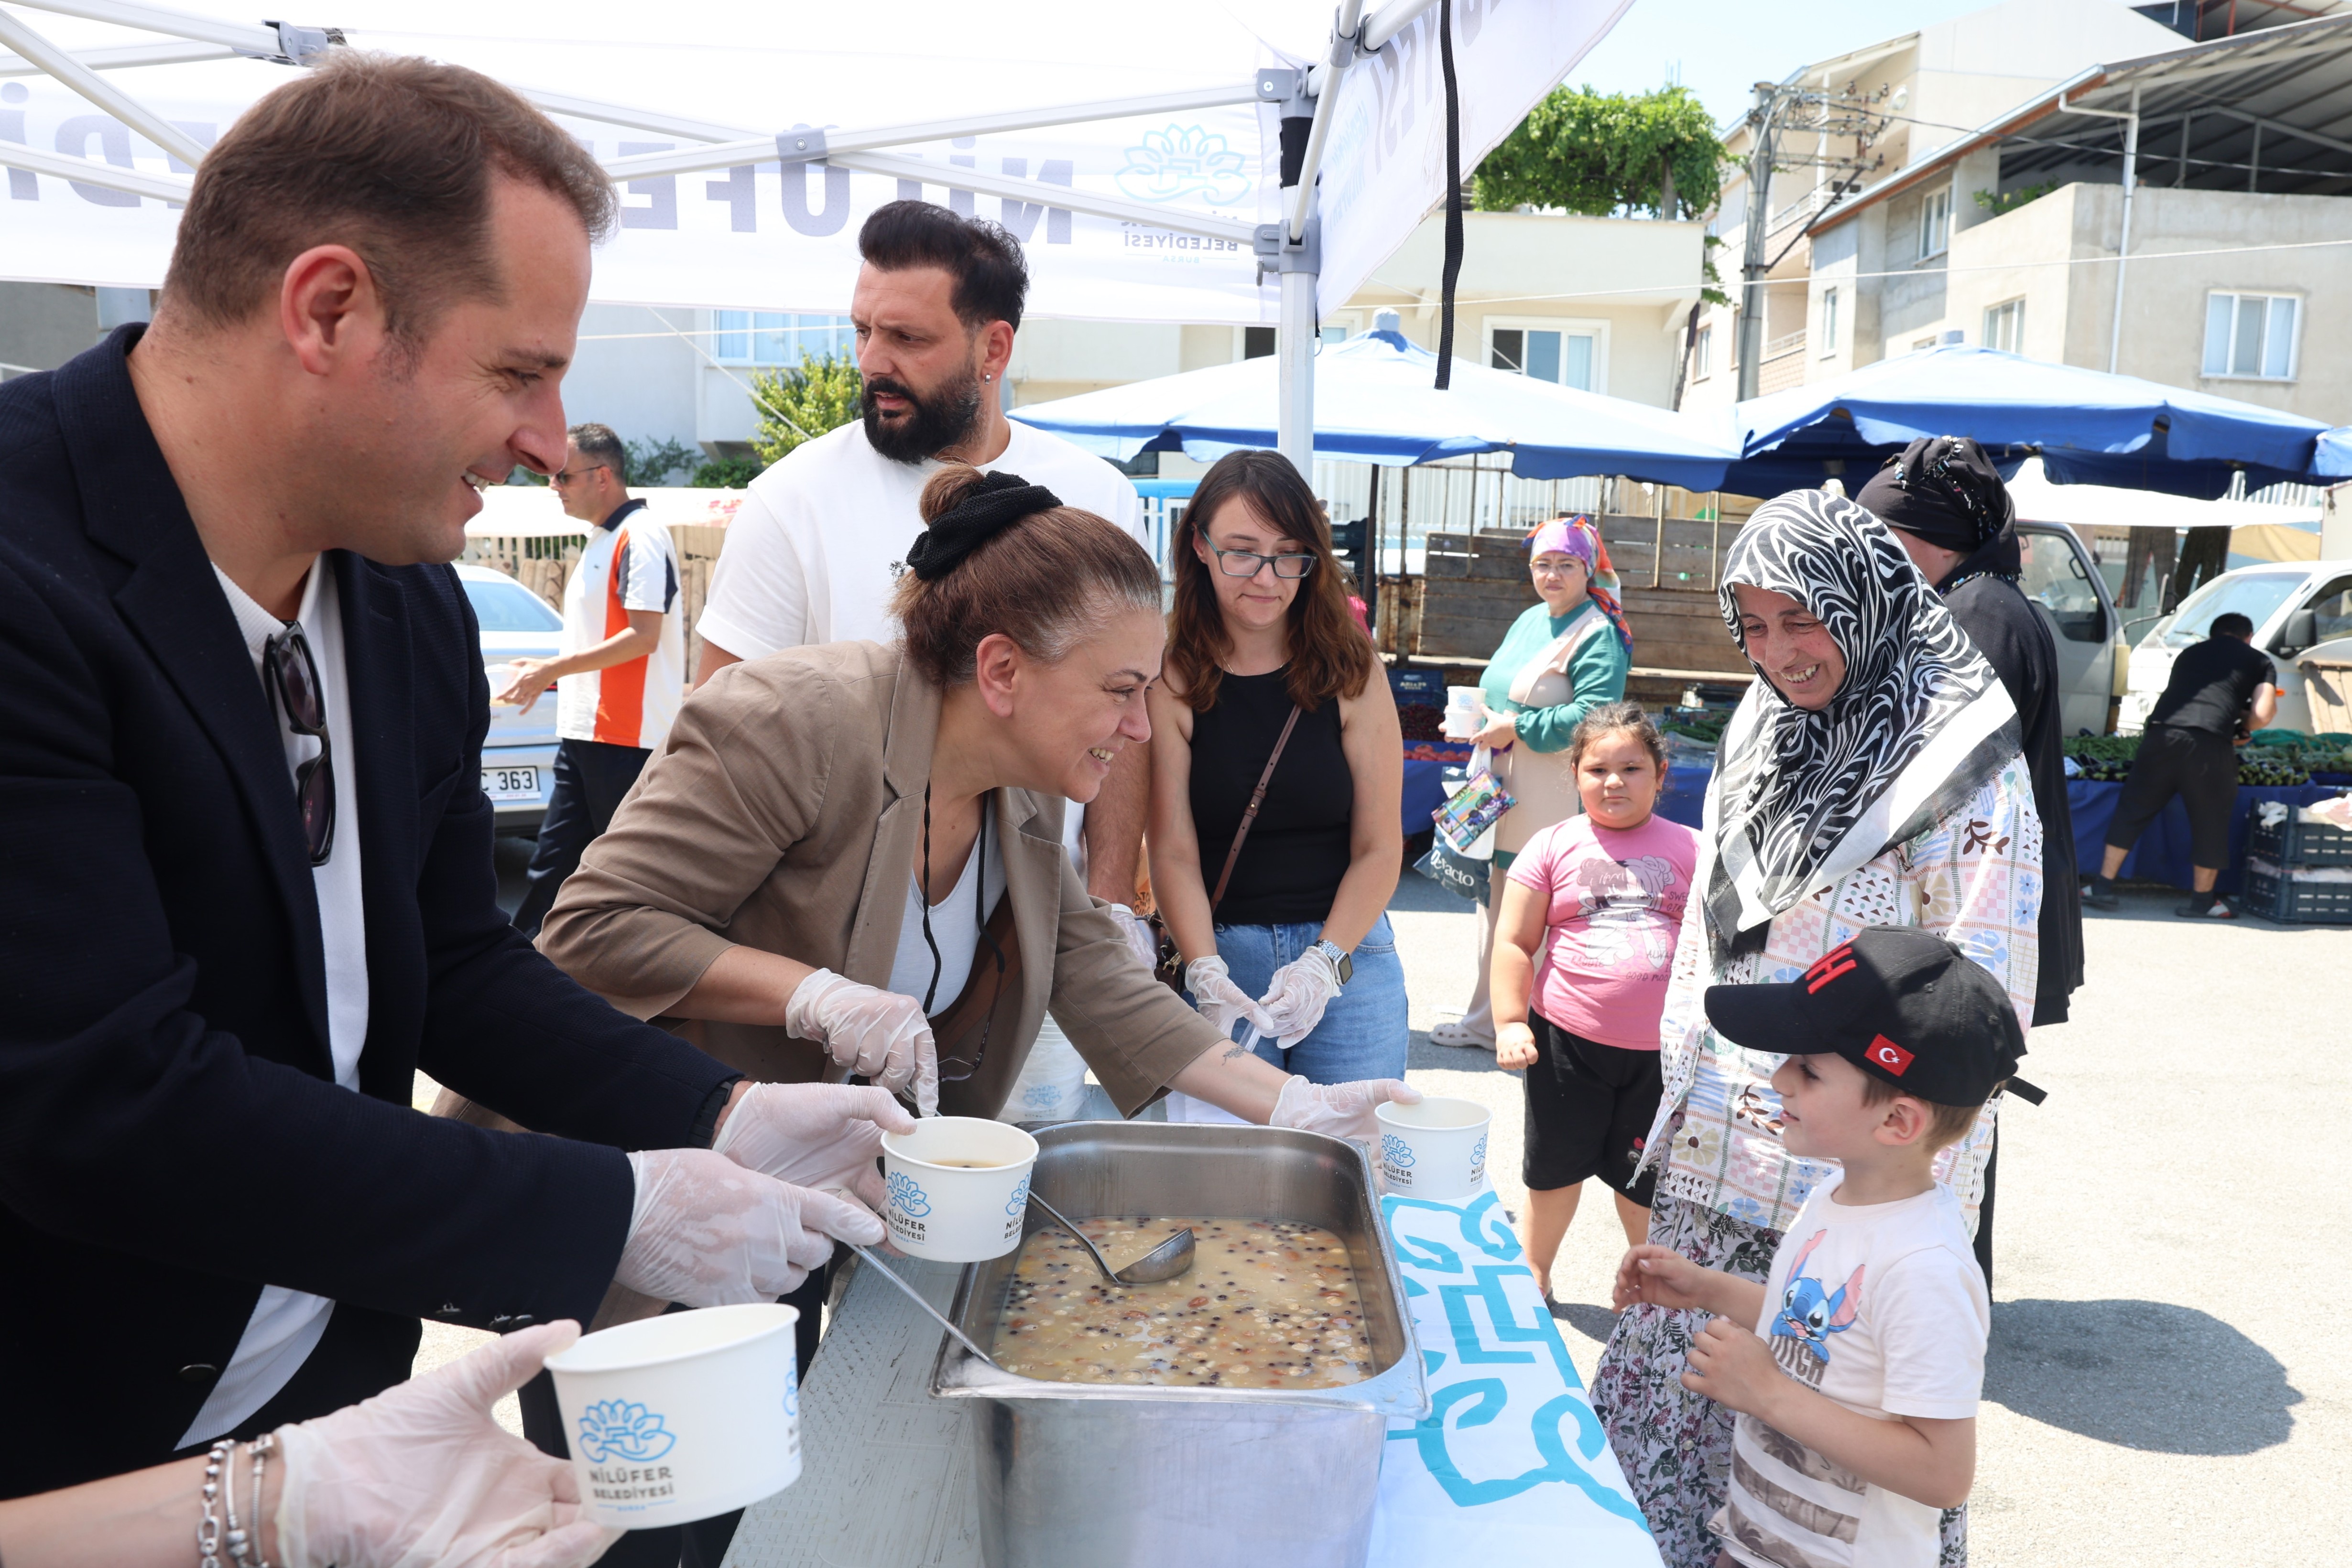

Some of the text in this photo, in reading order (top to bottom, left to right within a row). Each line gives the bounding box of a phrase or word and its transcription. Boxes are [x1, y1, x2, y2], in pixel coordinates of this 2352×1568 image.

[498, 771, 533, 790] 363
[1383, 1162, 1413, 1178] NİLÜFER
[1384, 1170, 1412, 1185] BELEDİYESİ
[888, 1207, 926, 1232] NİLÜFER
[888, 1219, 925, 1241] BELEDİYESİ
[588, 1465, 673, 1483] NİLÜFER
[593, 1481, 674, 1500] BELEDİYESİ
